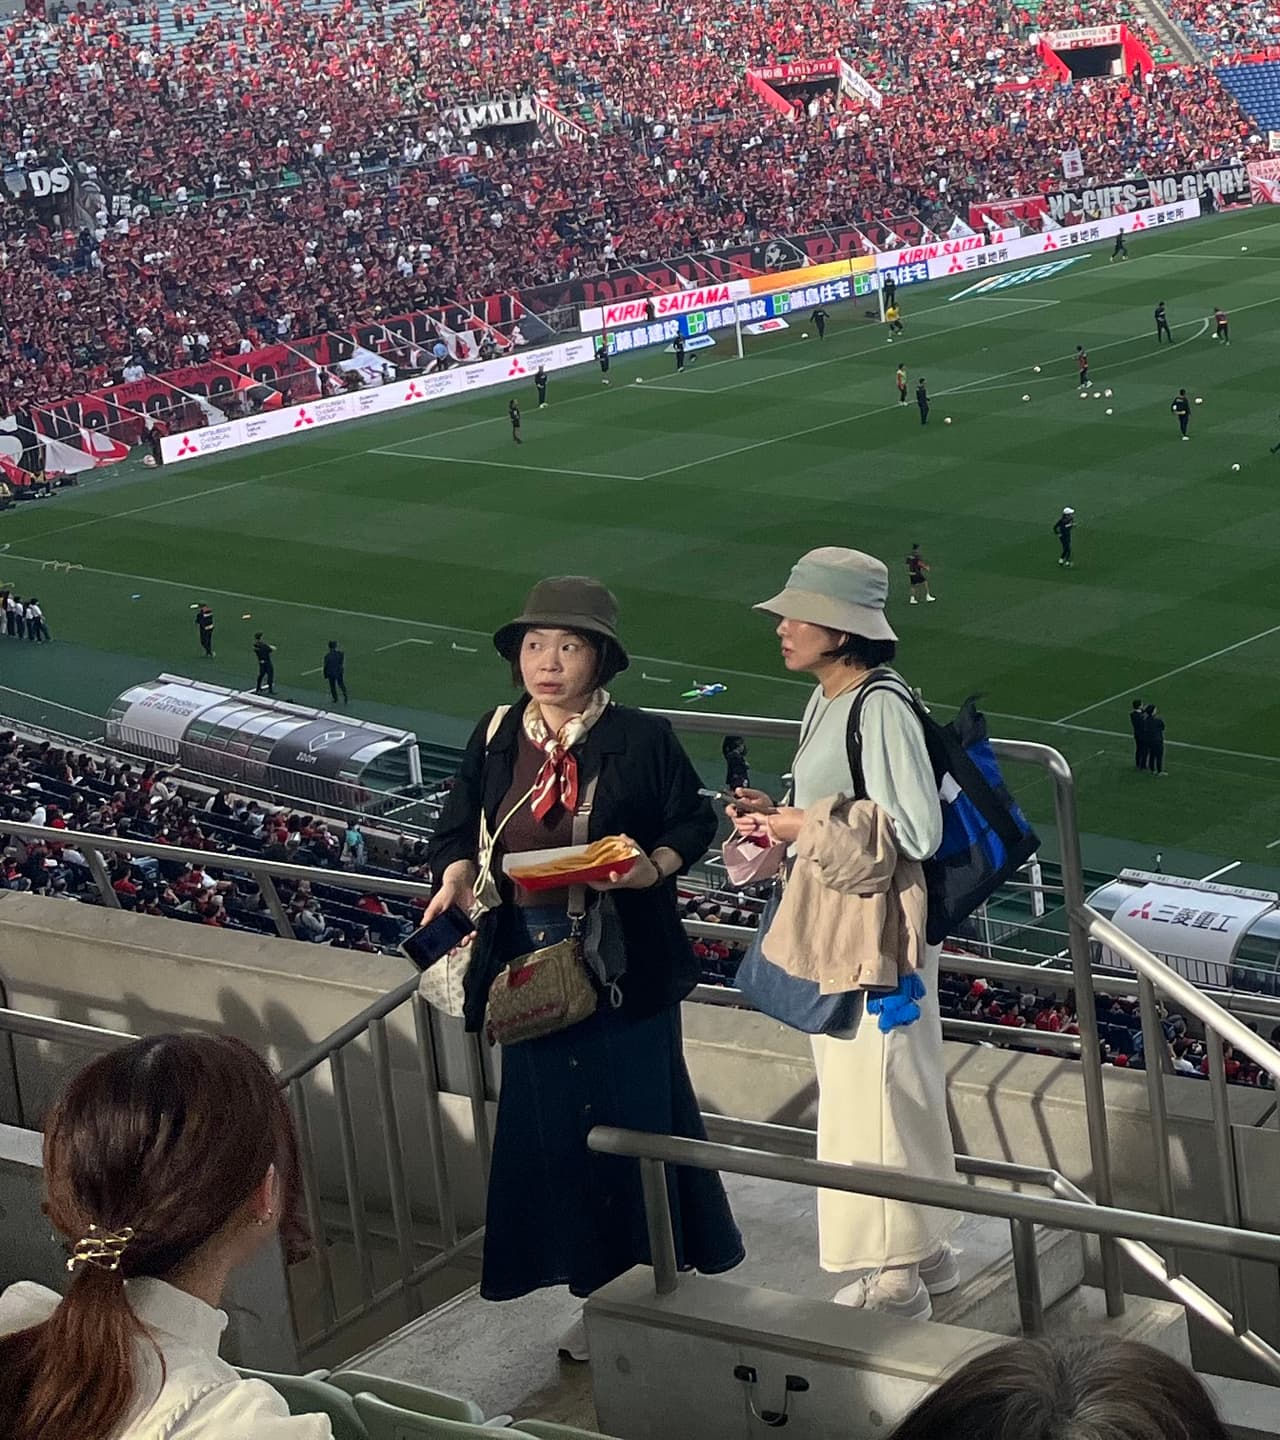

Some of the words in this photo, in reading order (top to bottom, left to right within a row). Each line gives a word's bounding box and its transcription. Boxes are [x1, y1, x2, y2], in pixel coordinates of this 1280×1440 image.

[28, 167, 70, 197] DS
[1147, 207, 1185, 226] 三菱地所
[898, 245, 940, 265] KIRIN
[943, 232, 1004, 256] SAITAA
[1060, 227, 1100, 246] 三菱地所
[966, 248, 1009, 268] 三菱地所
[657, 286, 731, 313] SAITAMA
[1151, 904, 1239, 933] 三菱重工
